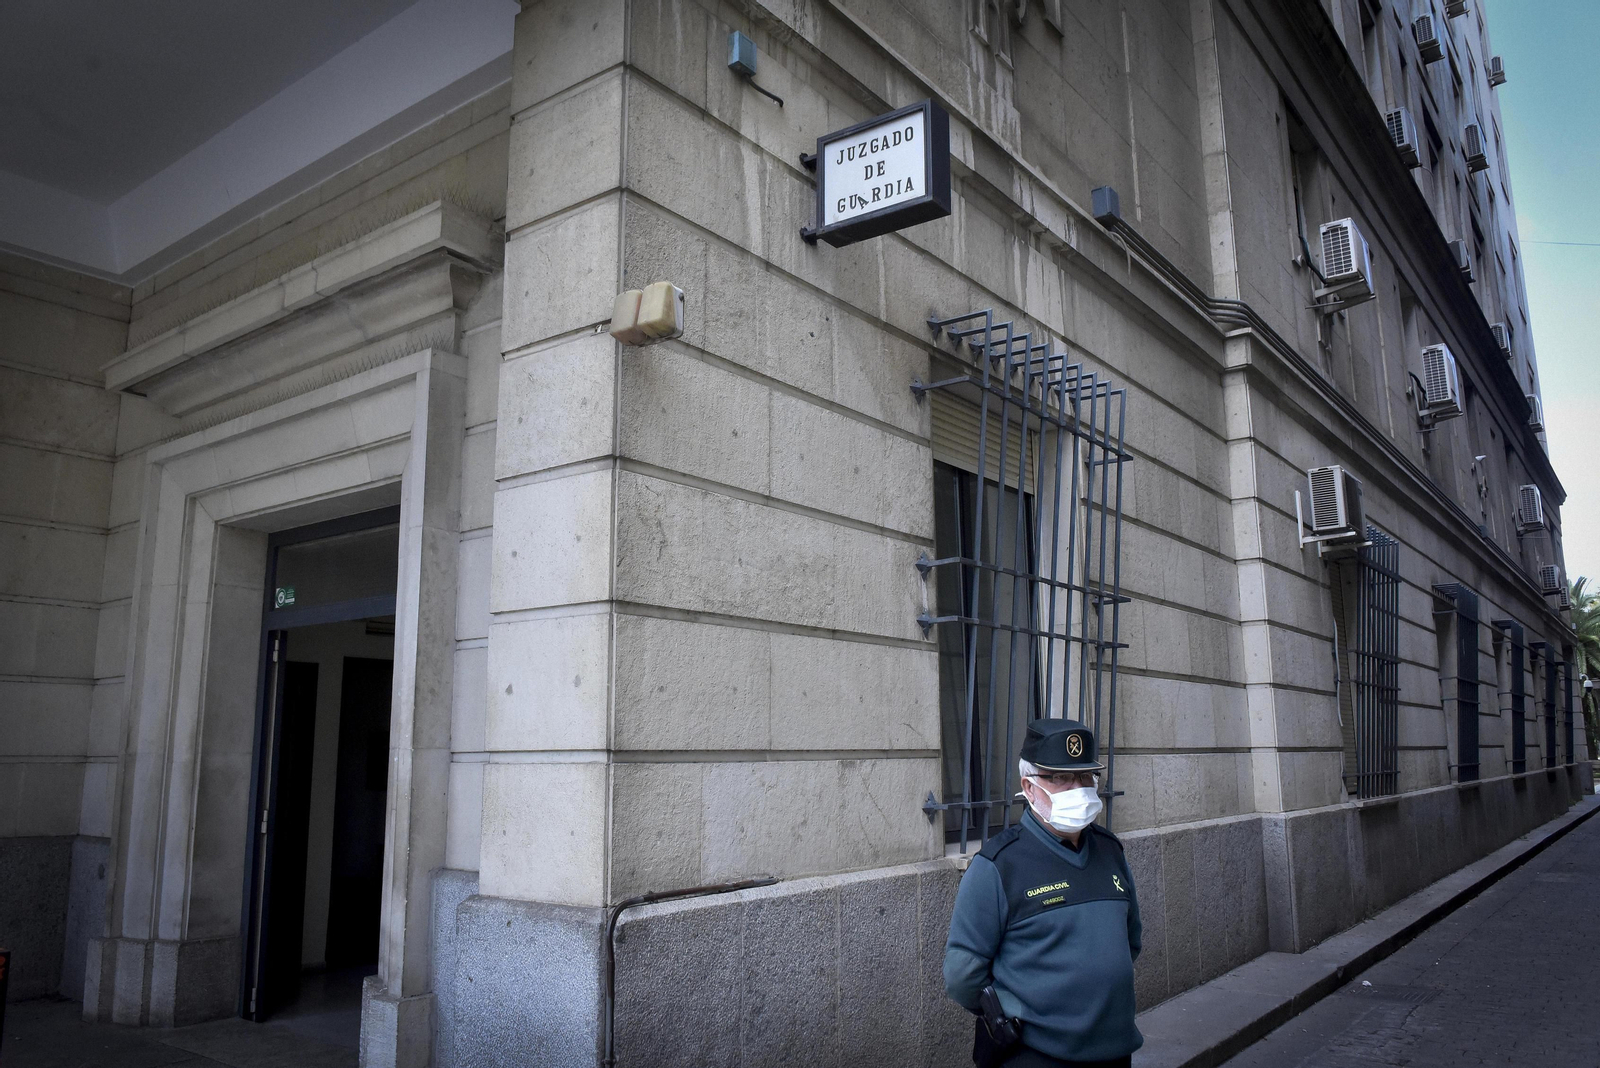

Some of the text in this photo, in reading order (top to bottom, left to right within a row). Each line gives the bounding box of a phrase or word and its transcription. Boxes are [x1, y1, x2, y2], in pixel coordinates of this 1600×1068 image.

[836, 126, 914, 166] JUZGADO
[864, 160, 886, 180] DE
[837, 177, 914, 213] GUARDIA
[1027, 882, 1070, 897] GUARDIA CIVIL
